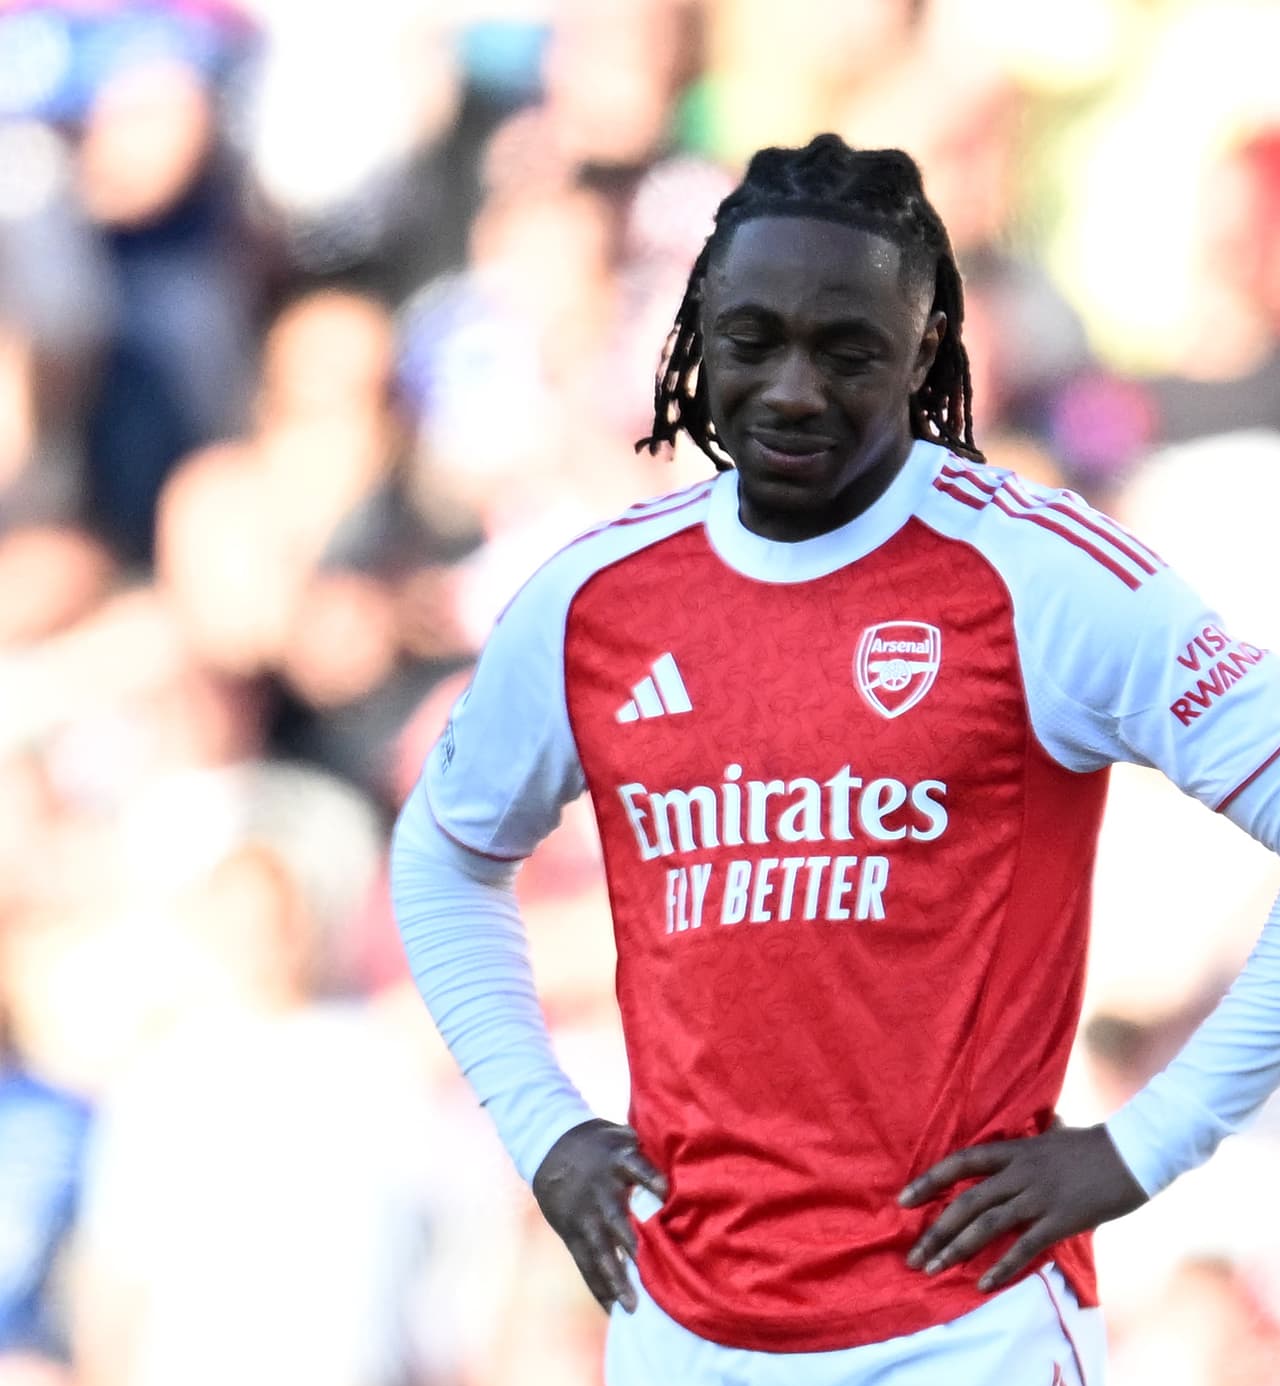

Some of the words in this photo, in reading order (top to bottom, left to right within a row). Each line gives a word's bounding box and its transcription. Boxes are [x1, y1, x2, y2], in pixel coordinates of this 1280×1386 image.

[871, 638, 930, 654] Arsenal
[1169, 642, 1269, 727] RWAND
[1176, 624, 1232, 672] VISI
[618, 763, 949, 862] Emirates
[666, 863, 712, 935] FLY
[720, 856, 890, 926] BETTER
